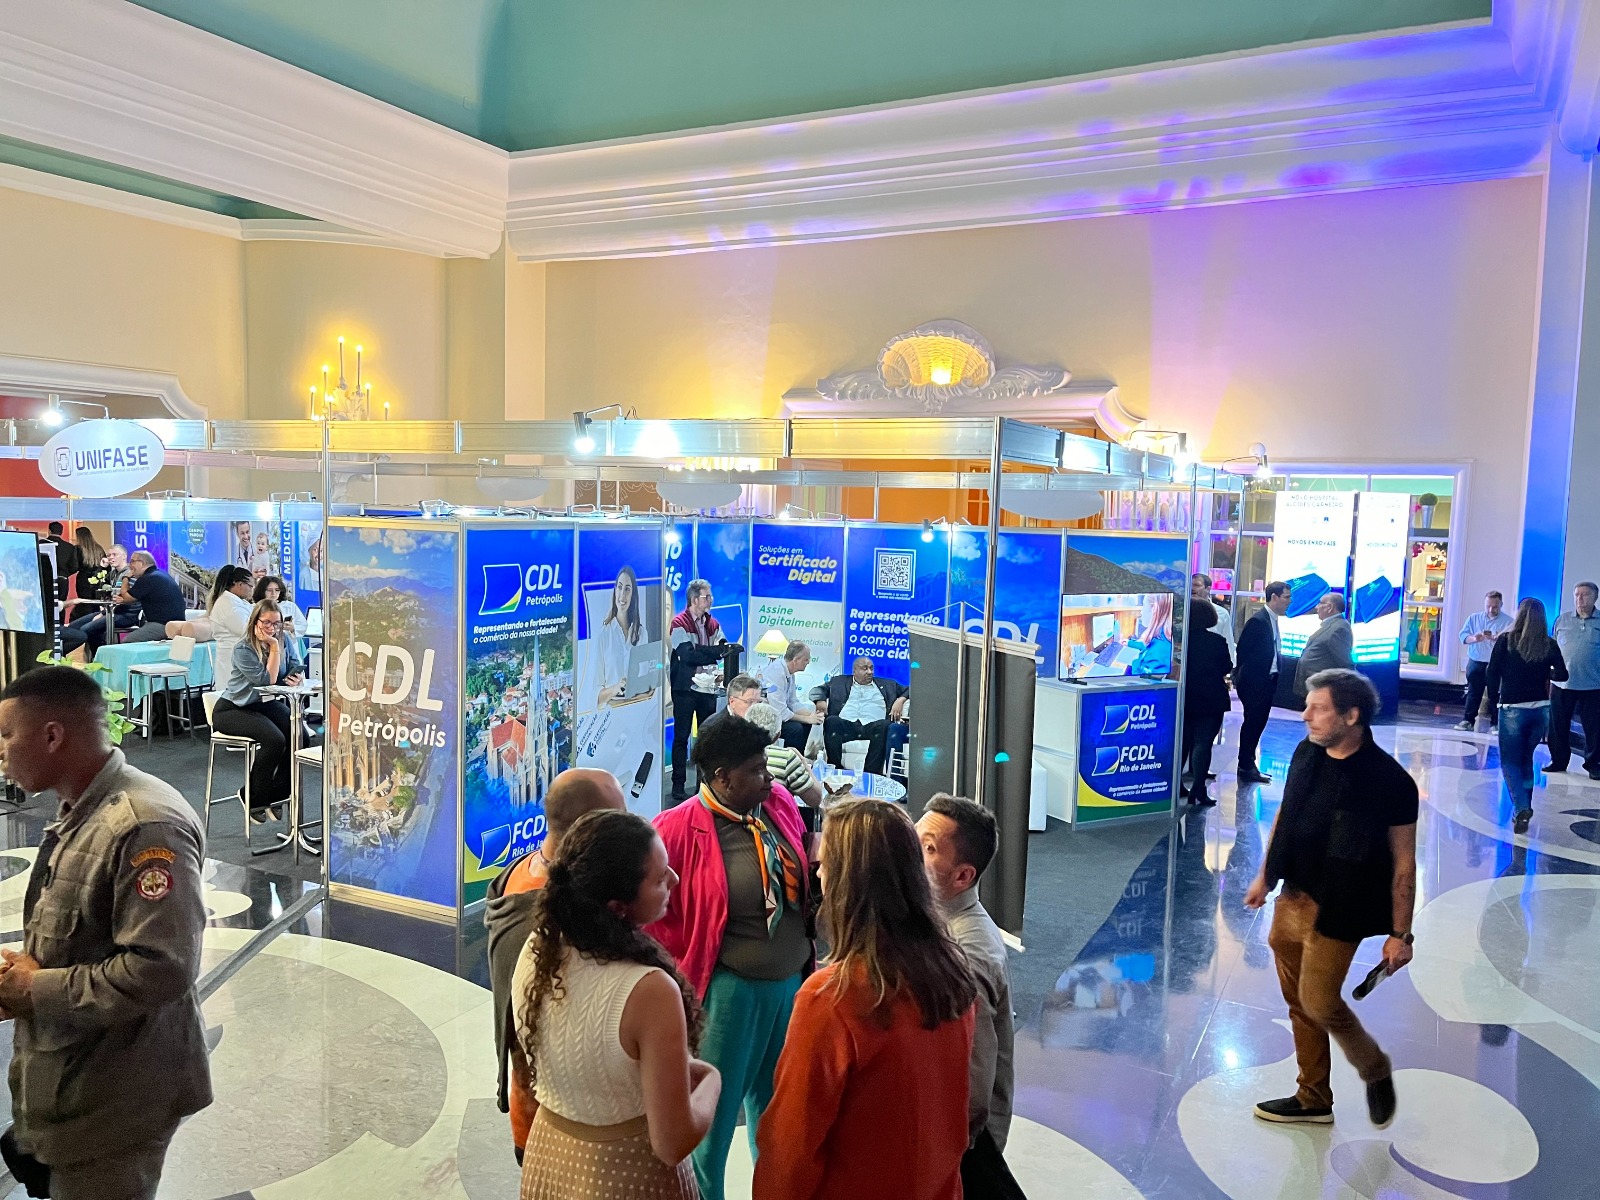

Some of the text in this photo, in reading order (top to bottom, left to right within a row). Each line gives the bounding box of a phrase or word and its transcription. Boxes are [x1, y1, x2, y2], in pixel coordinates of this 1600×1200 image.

[75, 445, 149, 471] UNIFASE
[758, 545, 790, 554] Soluções
[758, 553, 838, 569] Certificado
[525, 563, 562, 592] CDL
[787, 568, 837, 585] Digital
[525, 593, 563, 606] Petrópolis
[758, 604, 794, 615] Assine
[849, 608, 940, 625] Representando
[473, 620, 523, 635] Representando
[529, 615, 568, 627] fortalecendo
[758, 615, 835, 630] Digitalmente!
[478, 632, 509, 643] comércio
[509, 631, 518, 639] da
[518, 629, 536, 637] nossa
[536, 625, 559, 635] cidade!
[849, 635, 858, 643] o
[848, 646, 885, 657] nossa
[336, 641, 443, 711] CDL
[1129, 704, 1156, 721] CDL
[338, 713, 447, 748] Petrópolis
[1130, 722, 1157, 730] Petrópolis
[1120, 744, 1156, 763] FCDL
[1119, 762, 1162, 773] Rio de Janeiro
[512, 847, 524, 858] Rio
[526, 841, 535, 851] de
